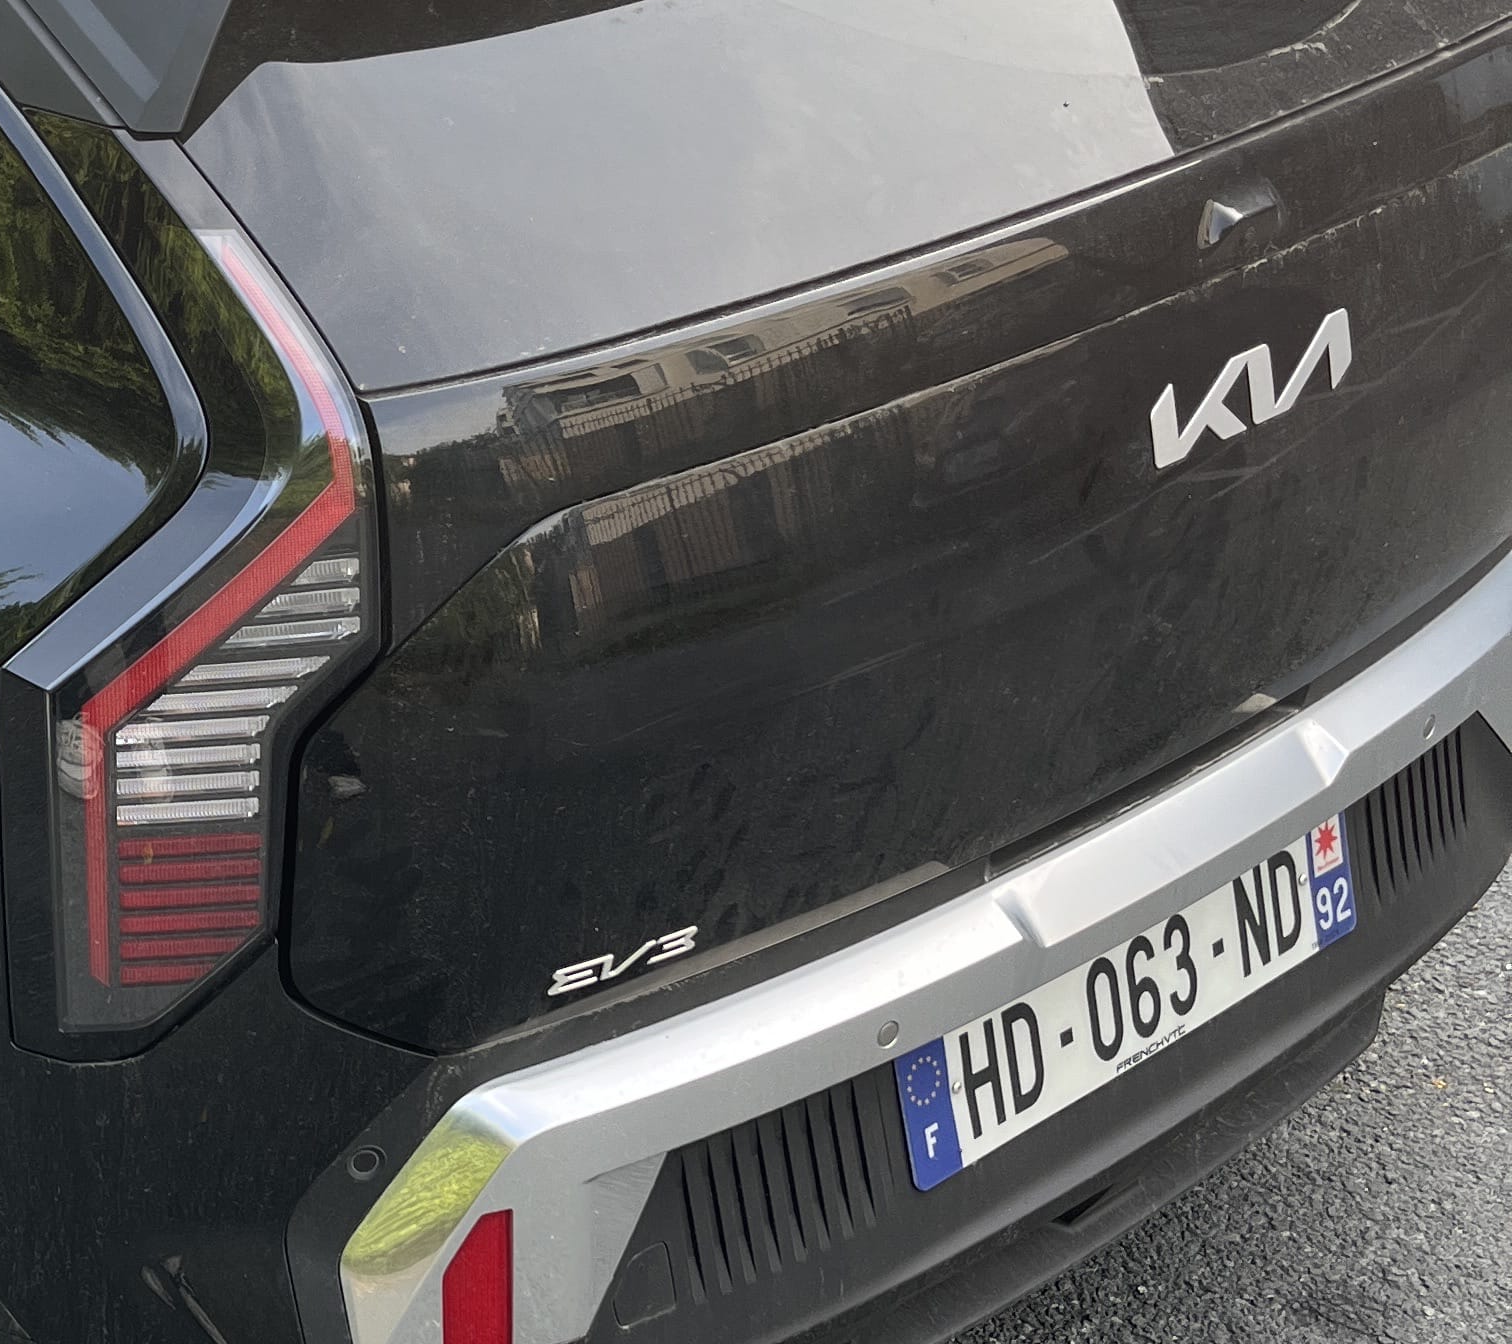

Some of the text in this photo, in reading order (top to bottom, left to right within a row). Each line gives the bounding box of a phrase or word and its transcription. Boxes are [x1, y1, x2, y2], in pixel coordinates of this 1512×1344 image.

[1150, 307, 1352, 469] KIA
[1316, 877, 1352, 930] 92
[547, 925, 698, 996] EV3
[924, 1122, 939, 1159] F
